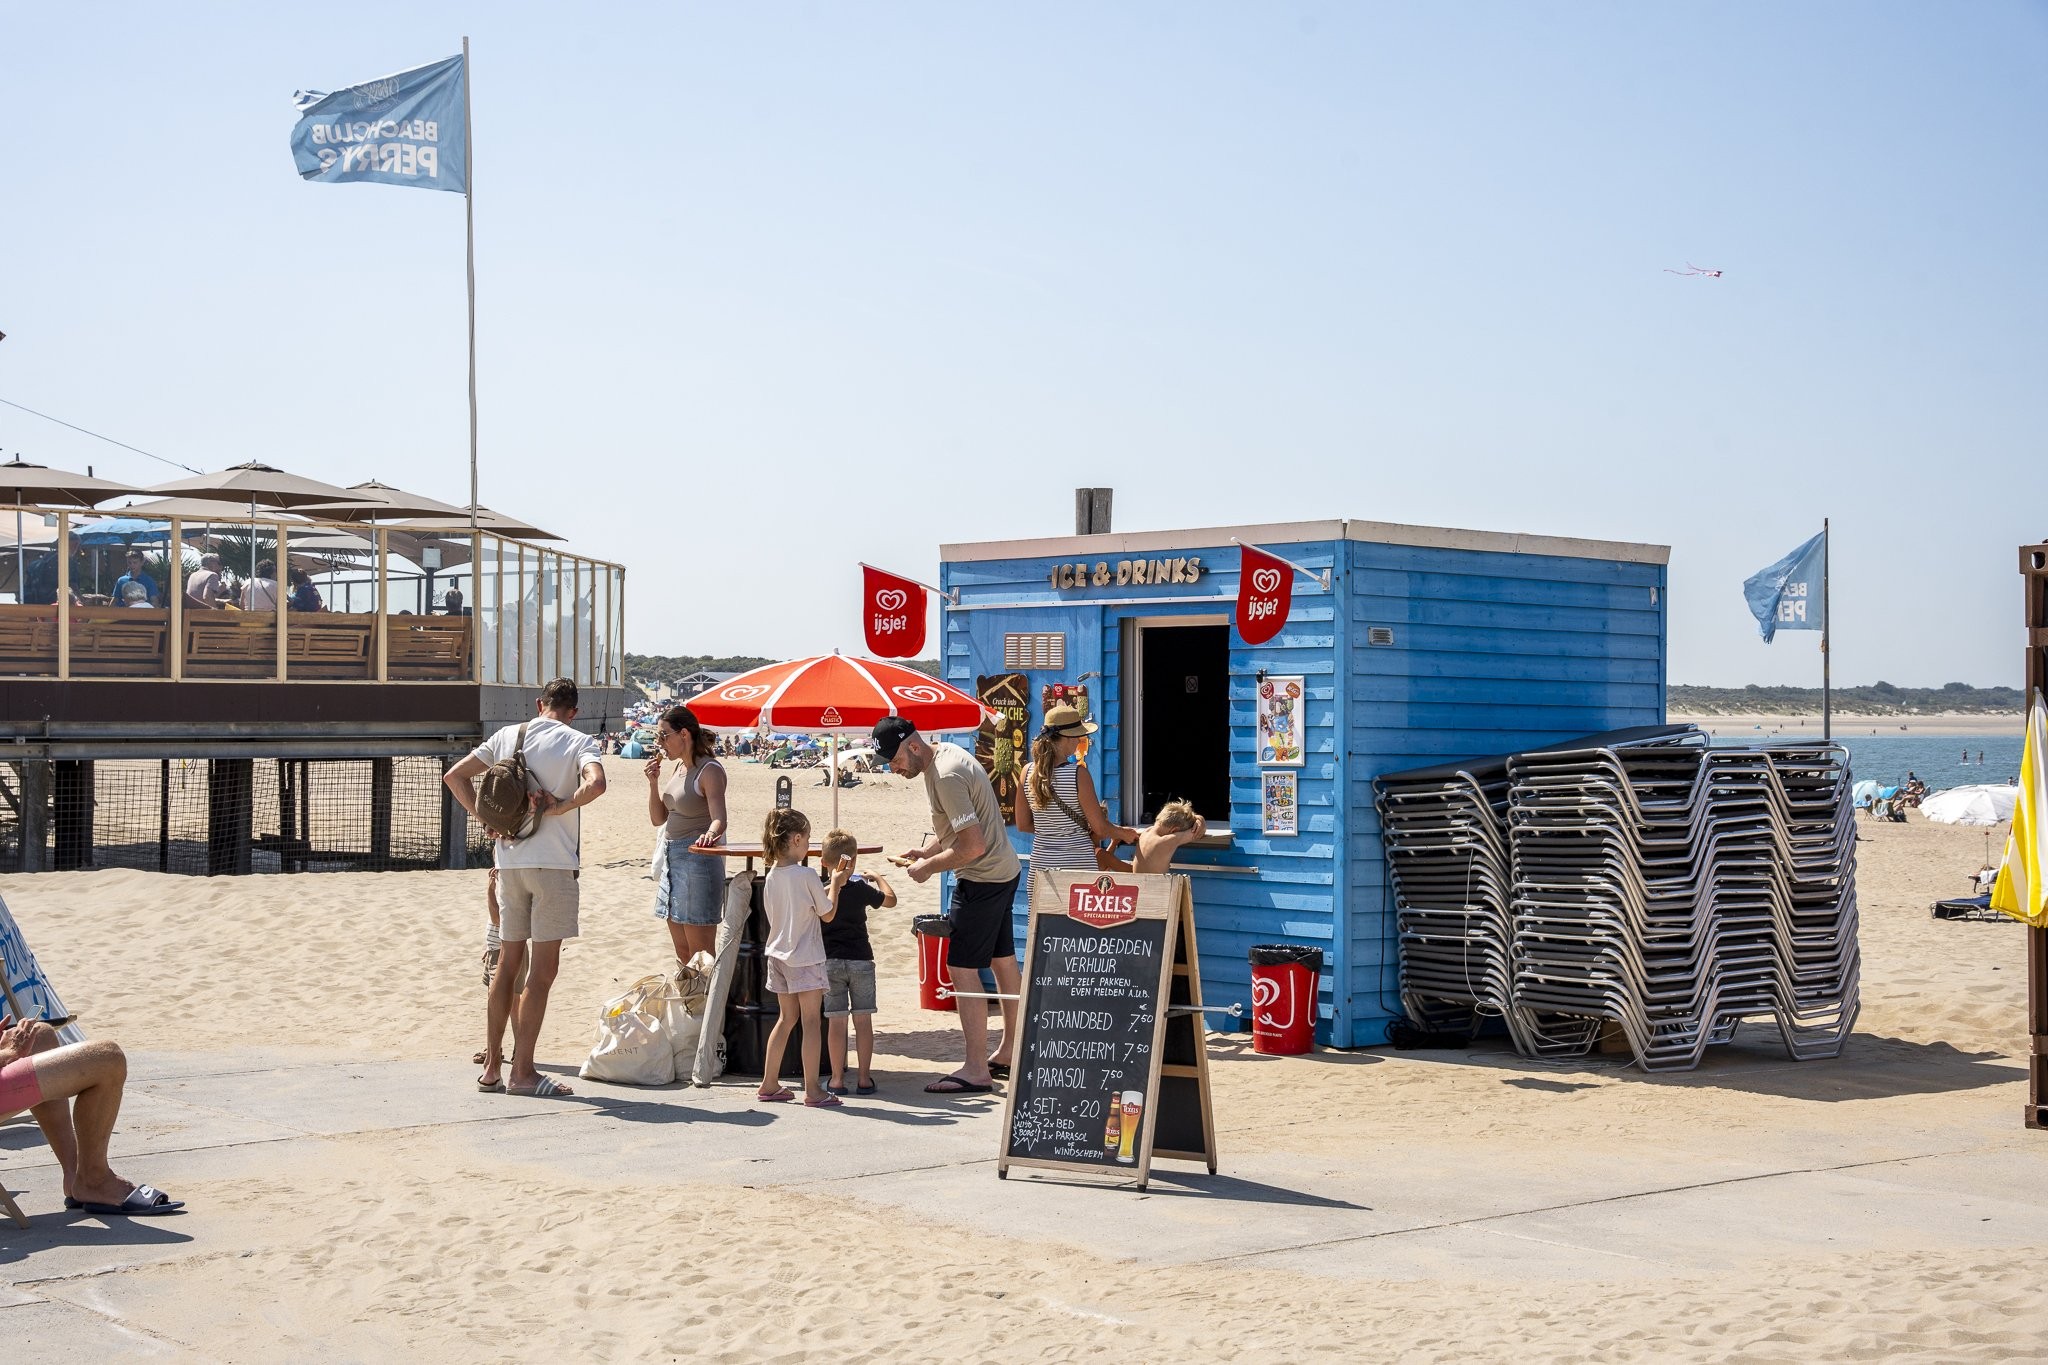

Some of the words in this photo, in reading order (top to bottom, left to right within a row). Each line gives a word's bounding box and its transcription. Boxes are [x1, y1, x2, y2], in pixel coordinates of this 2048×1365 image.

[1052, 563, 1087, 590] ICE
[1092, 562, 1111, 586] &
[1117, 556, 1201, 586] DRINKS
[1248, 596, 1279, 621] ijsje?
[874, 613, 908, 635] ijsje?
[1065, 956, 1117, 973] VERHUUR
[1077, 977, 1096, 986] ZELF
[1071, 987, 1091, 996] EVEN
[1094, 987, 1124, 997] MELDEN
[1041, 1011, 1113, 1031] STRANDBED
[1036, 1067, 1087, 1089] PARASOL
[1033, 1096, 1062, 1115] SET:
[1056, 1118, 1075, 1130] BED
[1055, 1130, 1088, 1142] PARASOL
